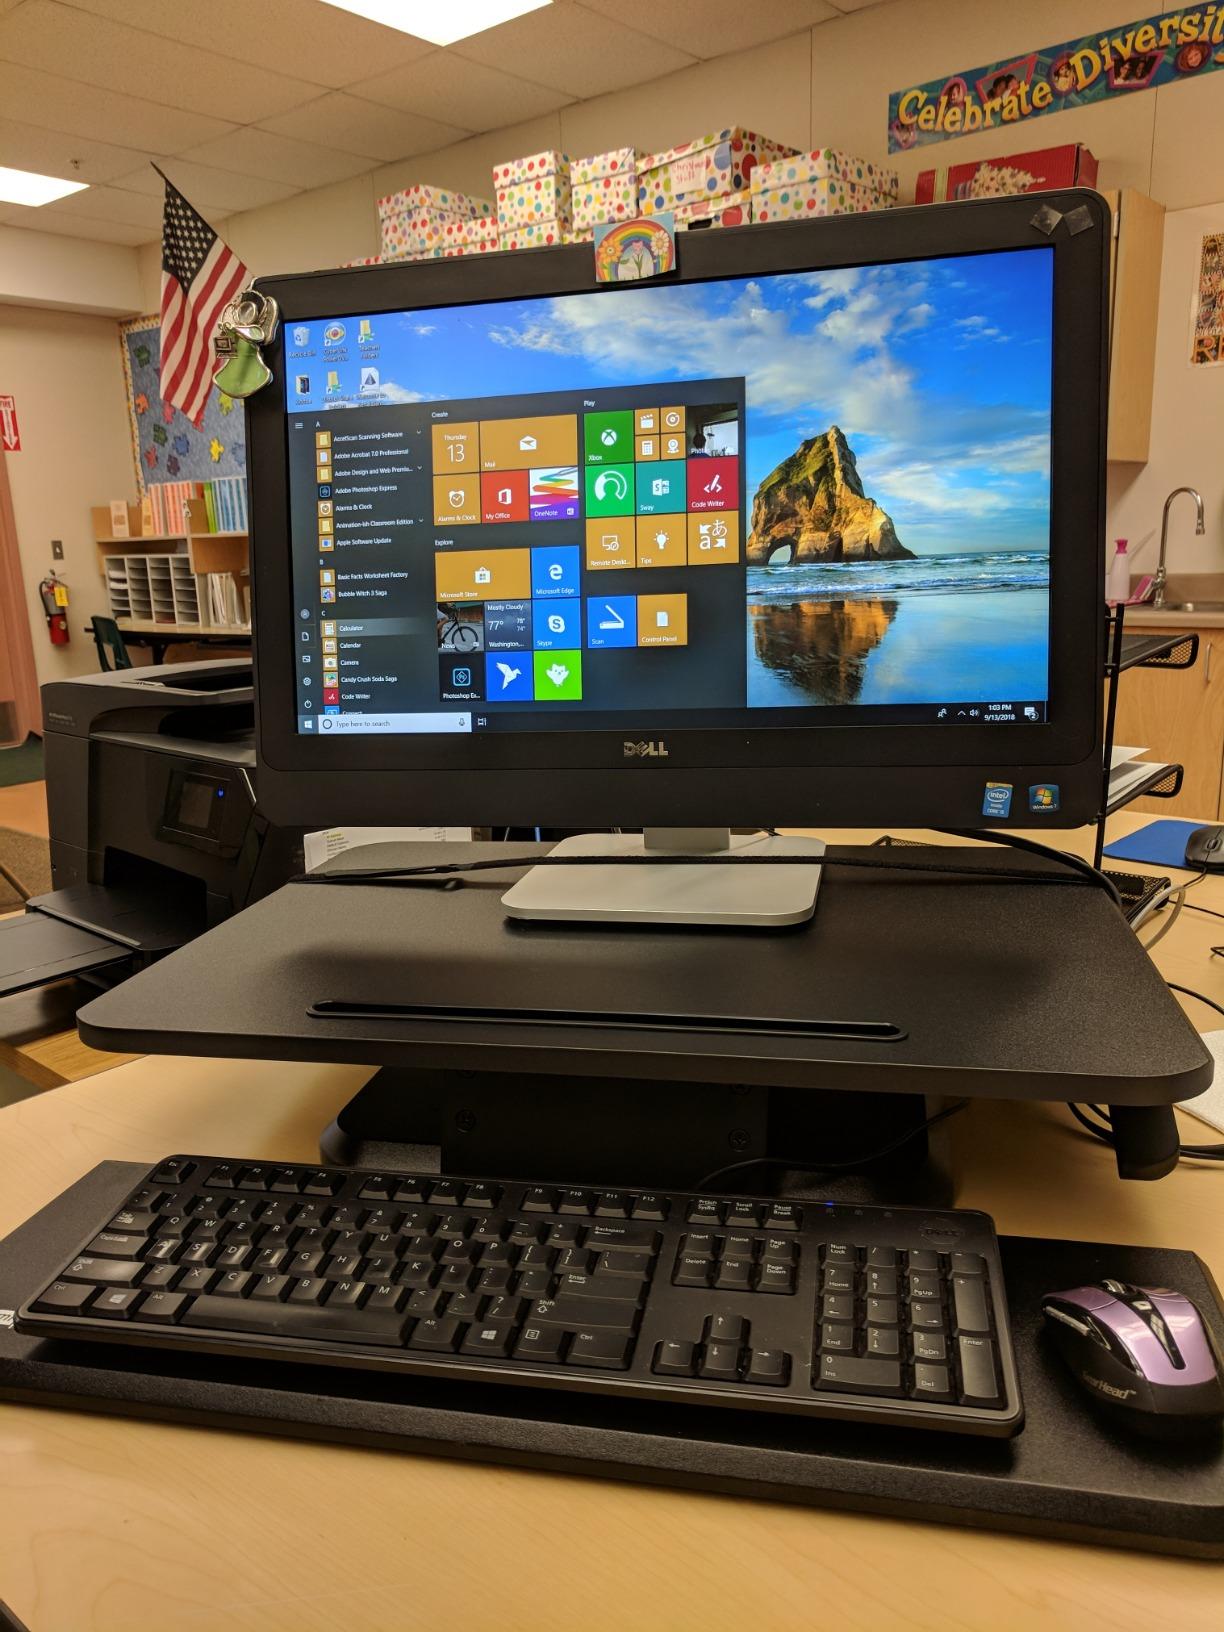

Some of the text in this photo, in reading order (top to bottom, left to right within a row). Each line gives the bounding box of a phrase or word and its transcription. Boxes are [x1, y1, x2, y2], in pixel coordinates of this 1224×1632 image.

[897, 5, 1224, 133] Celebrate Diversit
[583, 400, 596, 408] Play
[358, 433, 381, 441] Scanning
[381, 431, 404, 439] Software
[351, 451, 371, 459] Acrobat
[380, 449, 409, 457] Professional
[446, 443, 465, 463] 13
[352, 485, 379, 493] Photoshop
[379, 484, 398, 492] Express
[358, 503, 373, 511] Clock
[640, 504, 655, 512] Sway
[691, 499, 725, 509] Code Writer
[534, 509, 559, 517] OneNote
[370, 519, 396, 527] Classroom
[396, 518, 414, 526] Edition
[336, 537, 392, 547] Apple Software Update
[434, 539, 454, 547] Explore
[640, 557, 652, 565] Tips
[337, 573, 350, 581] Basic
[364, 572, 390, 580] Worksheet
[390, 571, 408, 579] Factory
[356, 589, 371, 597] Witch
[375, 589, 388, 597] Saga
[439, 590, 479, 599] Microsoft Store
[535, 586, 575, 595] Microsoft Edge
[487, 603, 524, 612] Mostly Cloudy
[339, 624, 364, 632] Calculator
[487, 620, 504, 631] 77°
[641, 635, 678, 644] Control Panel
[340, 659, 360, 667] Camera
[340, 676, 357, 684] Candy
[371, 675, 385, 683] Soda
[385, 675, 398, 684] Saga
[442, 692, 470, 700] Photoshop
[988, 704, 1001, 712] 1:03
[983, 713, 1016, 722] 9/13/2018
[336, 720, 350, 729] Type
[623, 740, 669, 757] DELL
[170, 1216, 180, 1225] Q
[204, 1219, 216, 1228] W
[236, 1222, 246, 1231] E
[309, 1228, 317, 1236] T
[344, 1231, 353, 1239] Y
[380, 1234, 389, 1242] U
[192, 1243, 201, 1251] S
[453, 1240, 463, 1248] O
[769, 1239, 786, 1247] Page
[228, 1246, 237, 1254] D
[264, 1249, 272, 1257] F
[300, 1252, 310, 1260] G
[337, 1255, 346, 1264] H
[154, 1266, 163, 1274] Z
[411, 1262, 421, 1270] K
[449, 1265, 456, 1273] L
[191, 1269, 201, 1278] X
[228, 1272, 237, 1280] C
[829, 1269, 836, 1277] 7
[871, 1272, 878, 1280] 8
[266, 1276, 275, 1284] V
[301, 1279, 310, 1287] B
[913, 1276, 920, 1284] 9
[340, 1282, 350, 1291] N
[378, 1286, 390, 1295] M
[913, 1289, 933, 1297] PgUp
[828, 1296, 836, 1304] 4
[871, 1300, 878, 1308] 5
[828, 1325, 833, 1333] 1
[872, 1329, 879, 1337] 2
[580, 1333, 593, 1341] Ctrl
[919, 1334, 925, 1342] 3
[826, 1338, 841, 1346] End
[962, 1338, 984, 1347] Enter
[918, 1347, 940, 1356] PgDn
[826, 1355, 833, 1364] 0
[825, 1369, 837, 1378] Ins
[921, 1380, 935, 1388] Del
